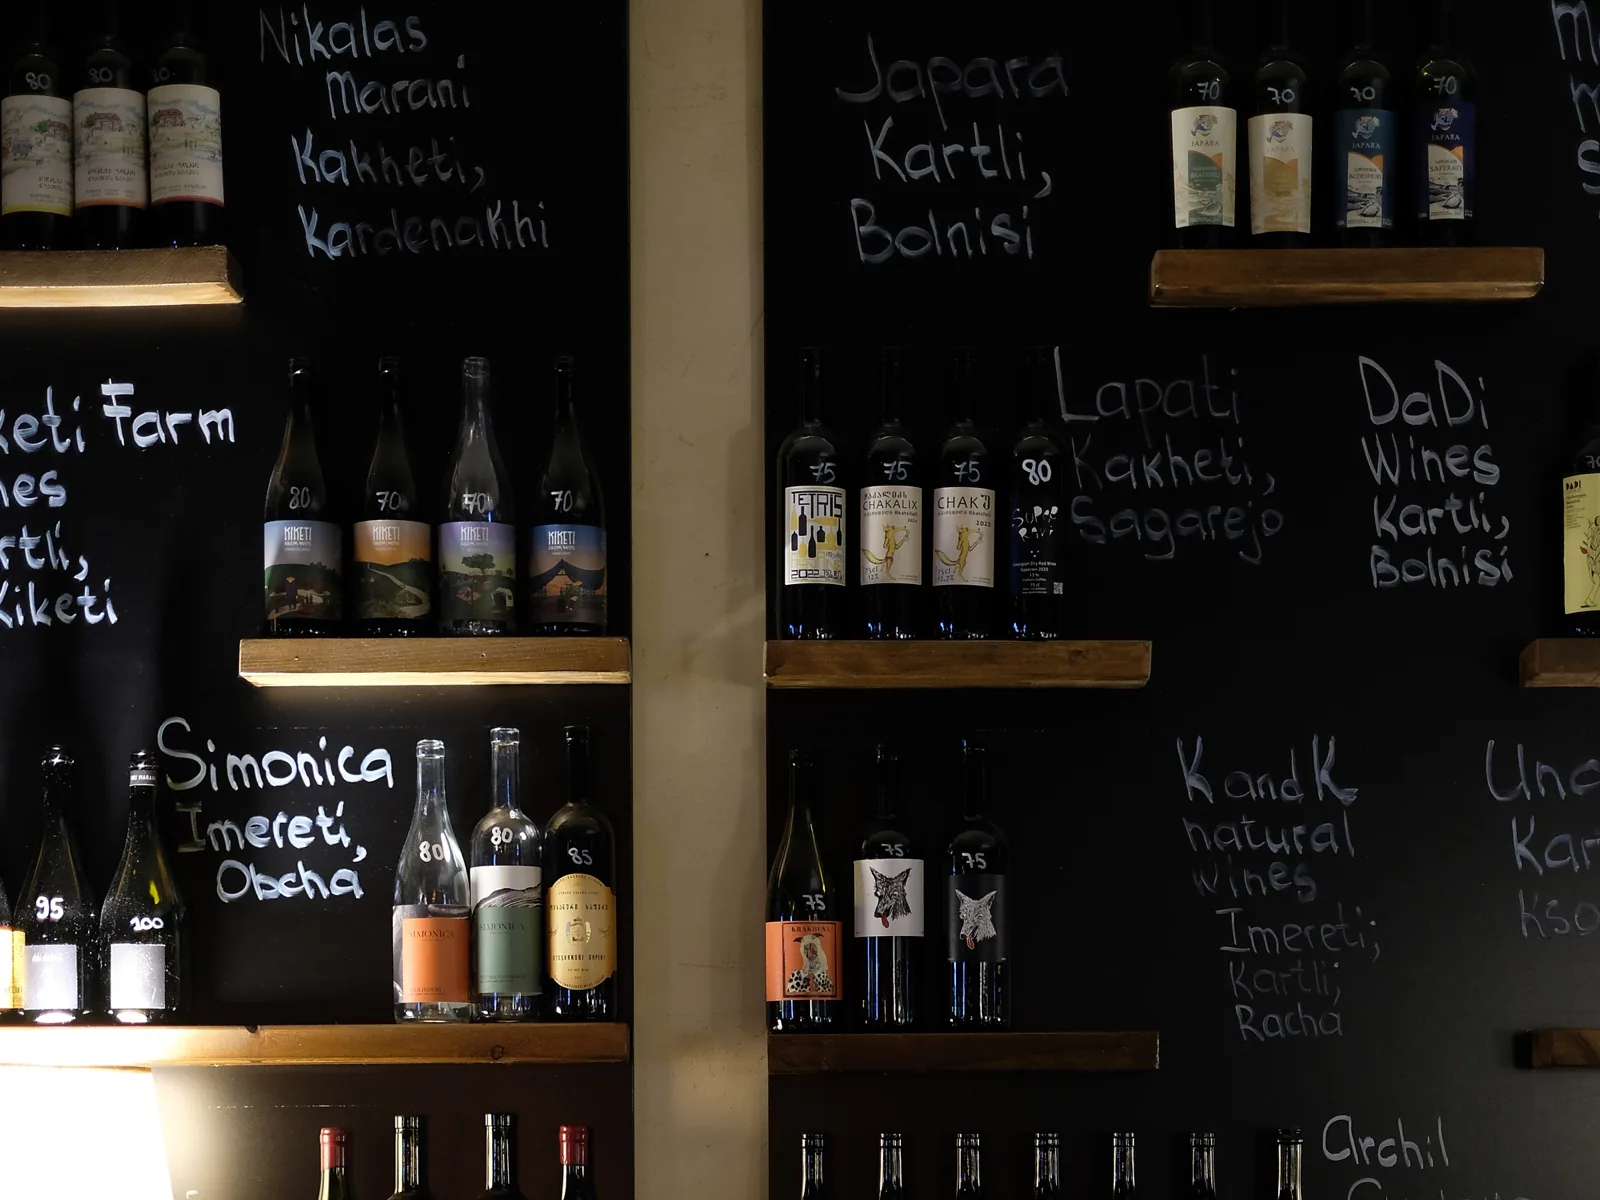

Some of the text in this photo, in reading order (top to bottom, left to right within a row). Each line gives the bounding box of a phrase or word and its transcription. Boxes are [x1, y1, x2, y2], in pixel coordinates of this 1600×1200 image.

[259, 2, 427, 67] Nikalas
[25, 71, 51, 90] 80
[88, 67, 114, 83] 80
[834, 31, 1069, 132] Japara
[1432, 75, 1457, 96] 70
[1196, 81, 1220, 100] 70
[1267, 86, 1296, 105] 70
[1350, 86, 1376, 102] 70
[863, 115, 1052, 200] Kartli,
[850, 198, 1034, 264] Bolnisi
[1054, 345, 1240, 449] Lapati
[101, 378, 236, 449] Farm
[883, 460, 914, 480] 75
[1070, 430, 1276, 497] Kakheti,
[1360, 432, 1500, 486] Wines
[810, 462, 837, 484] 75
[953, 461, 980, 482] 75
[1021, 459, 1052, 486] 80
[289, 486, 311, 510] 80
[376, 491, 401, 511] 70
[551, 490, 573, 512] 70
[862, 499, 918, 510] CHAKALIX
[1373, 491, 1510, 543] Kartli,
[284, 526, 312, 541] KIKETI
[373, 526, 400, 541] KIKETI
[461, 526, 489, 541] KIKETI
[548, 530, 576, 546] KIKETI
[1071, 495, 1284, 566] Sagarejo
[1370, 544, 1514, 589] Bolnisi
[158, 716, 394, 791] Simonica
[1176, 734, 1214, 804] K
[1312, 734, 1359, 806] K
[176, 801, 367, 862] Imereti,
[490, 826, 513, 844] 80
[1182, 808, 1355, 858] natural
[419, 840, 444, 862] 80
[568, 847, 593, 865] 85
[881, 843, 905, 857] 75
[961, 852, 988, 869] 75
[217, 859, 364, 903] Obcha
[35, 896, 64, 920] 95
[801, 894, 826, 911] 75
[130, 916, 164, 930] 100
[1235, 1002, 1343, 1042] Racha
